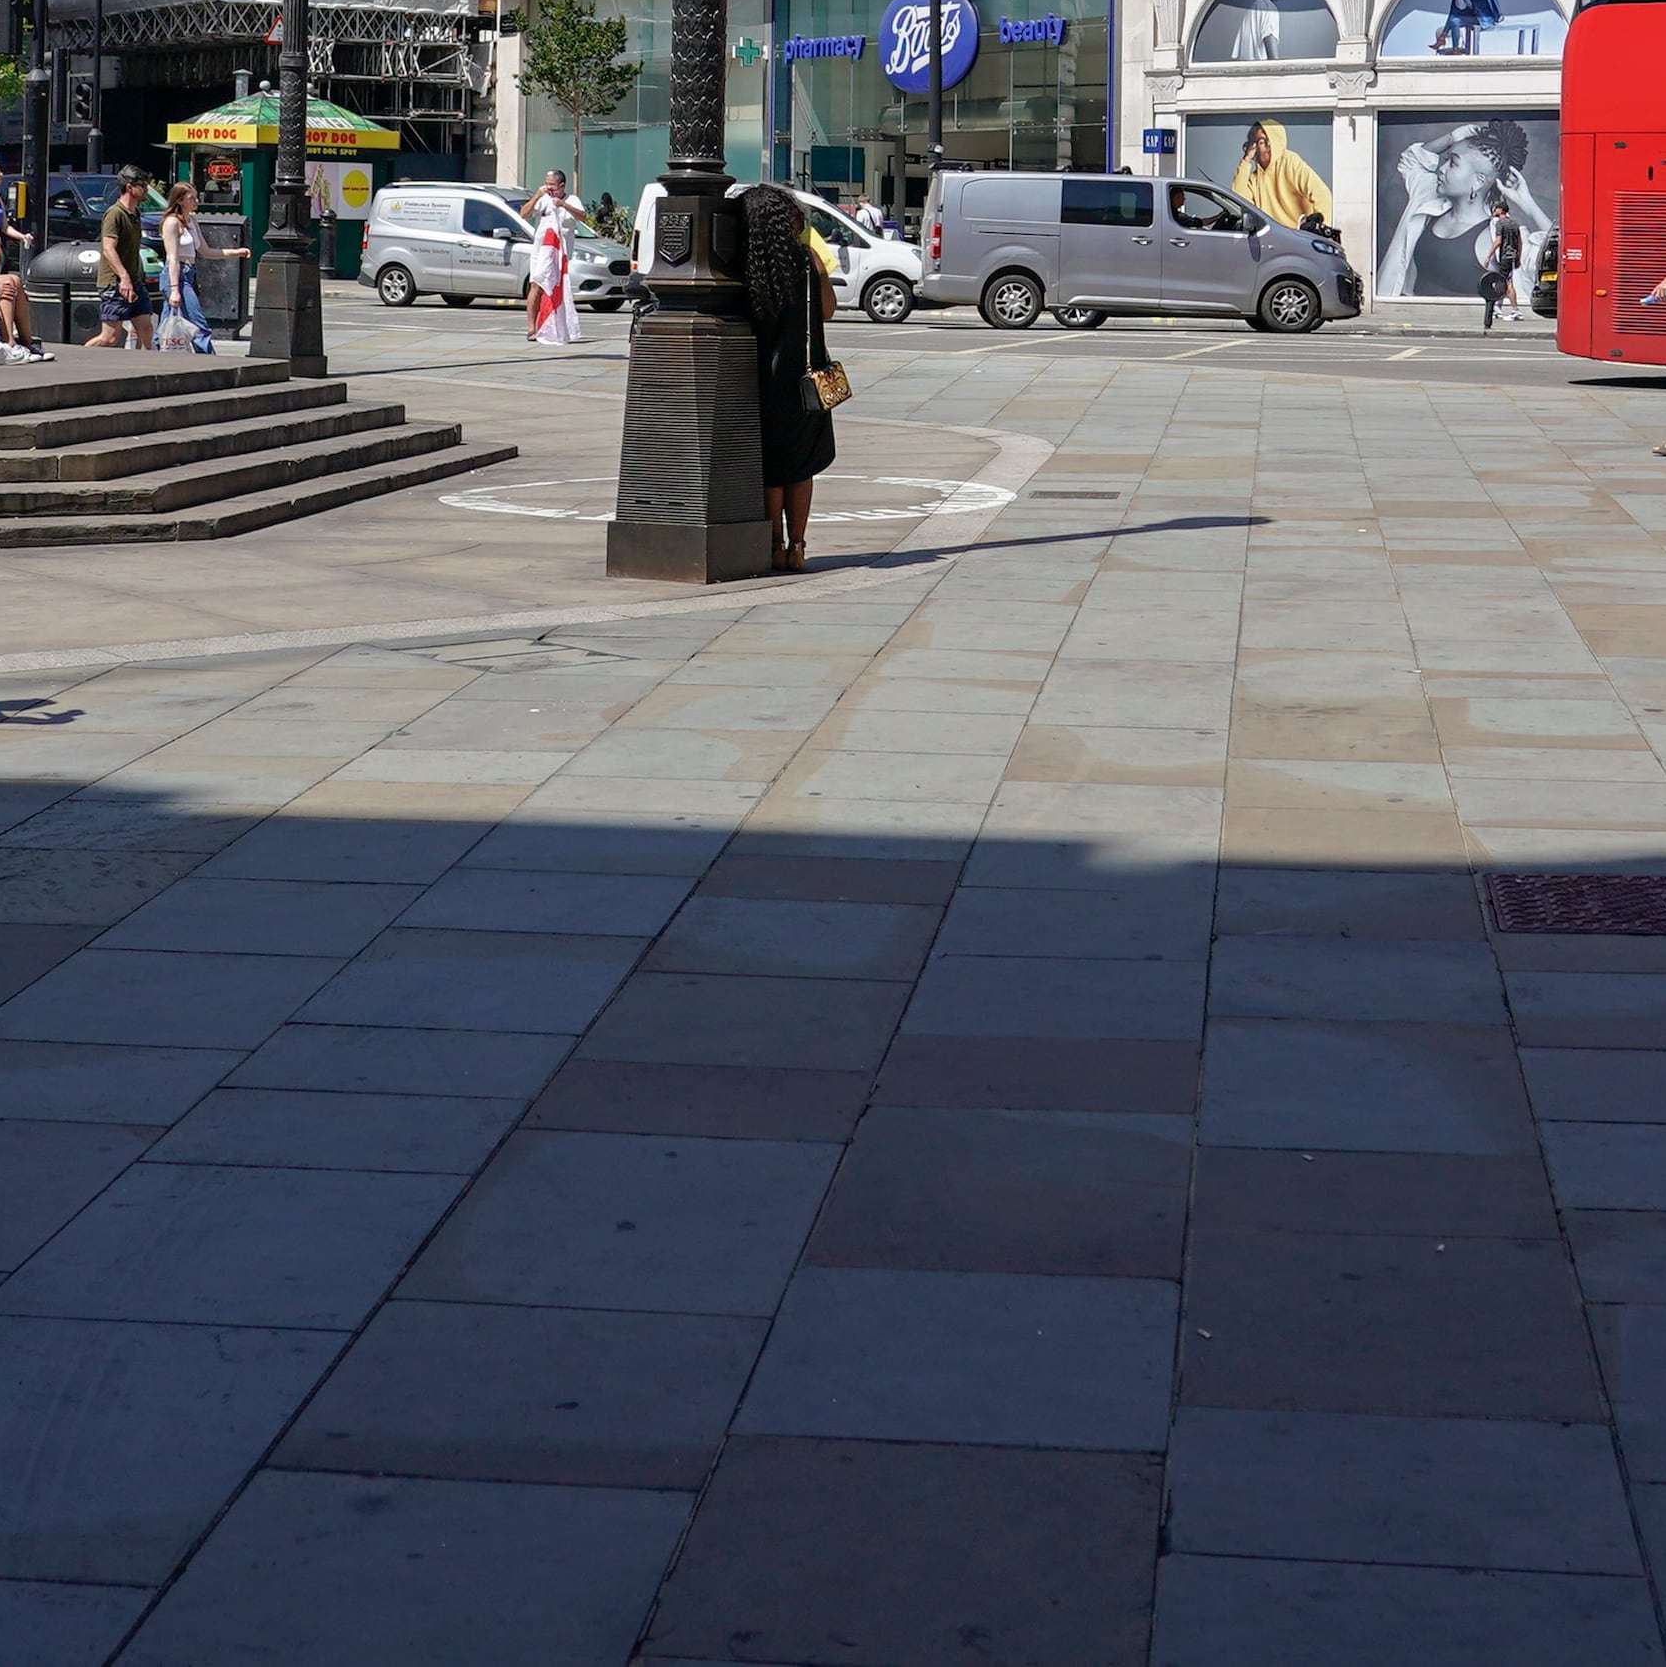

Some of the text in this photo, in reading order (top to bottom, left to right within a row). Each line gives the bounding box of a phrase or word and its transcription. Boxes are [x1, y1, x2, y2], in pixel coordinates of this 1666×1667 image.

[999, 13, 1067, 46] beauty
[783, 33, 866, 65] pharmacy
[187, 128, 237, 140] HOT DOG
[306, 131, 357, 145] HOT DOG
[1145, 135, 1159, 148] GAP
[322, 147, 338, 155] DOG
[339, 147, 358, 156] SPOT
